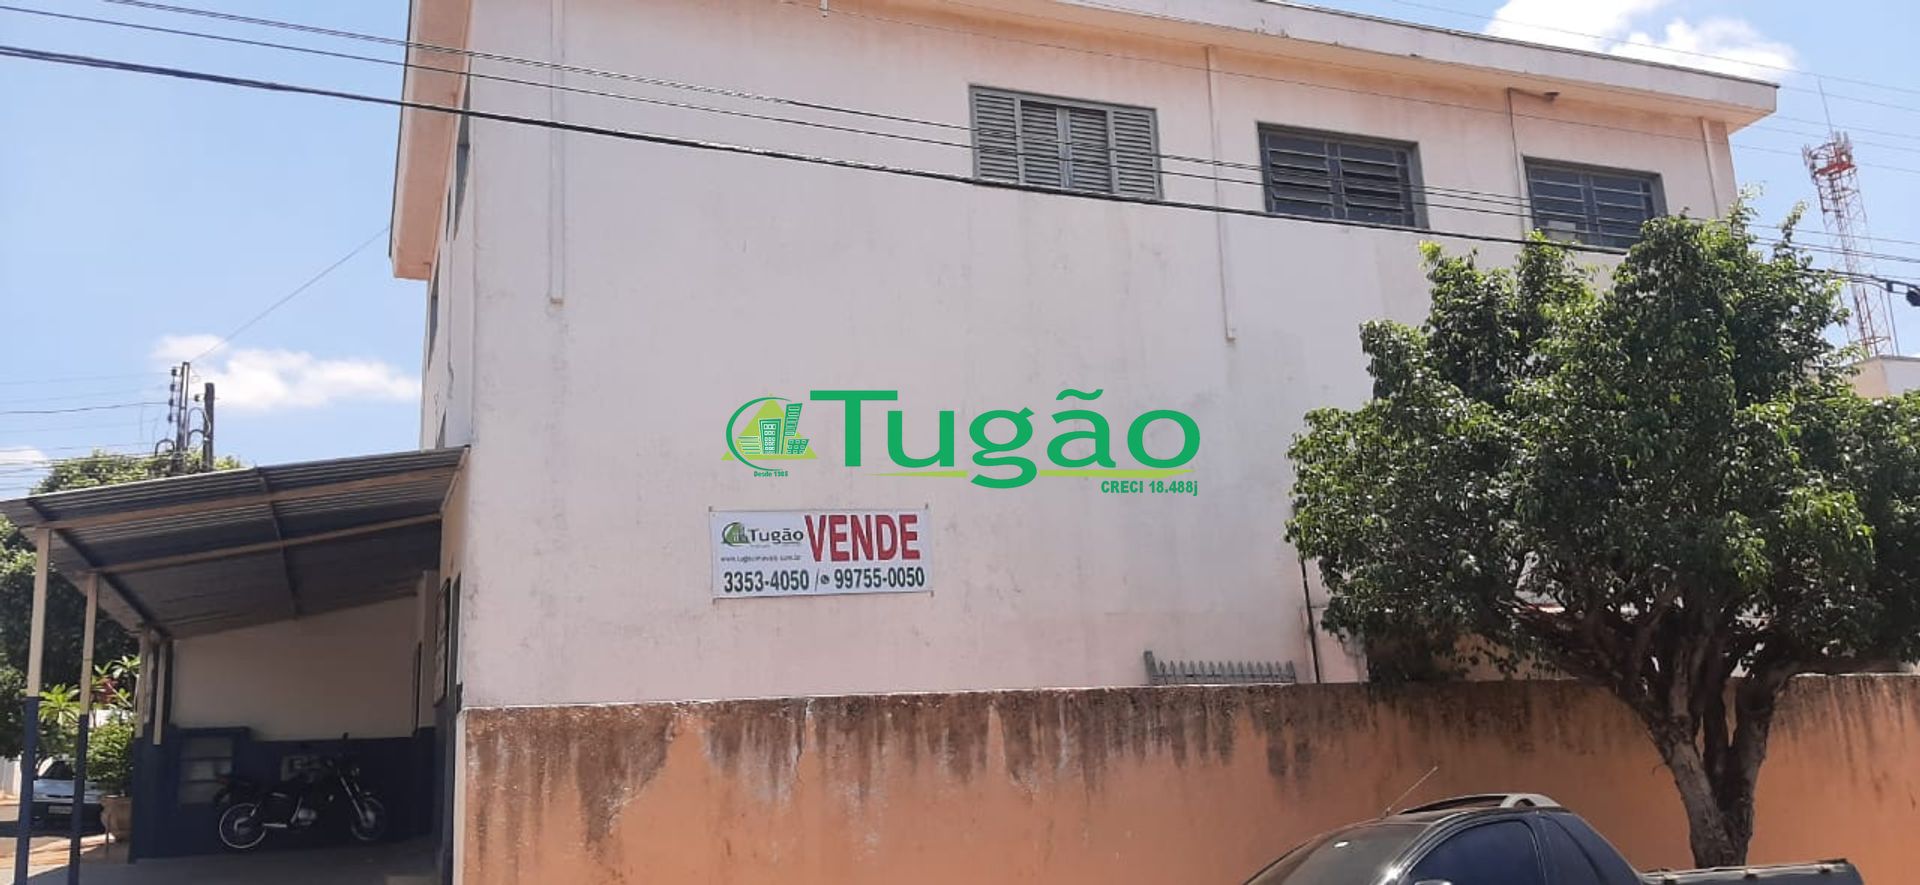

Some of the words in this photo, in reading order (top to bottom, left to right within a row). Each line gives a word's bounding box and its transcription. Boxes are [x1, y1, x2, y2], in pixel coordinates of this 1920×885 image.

[747, 528, 804, 544] Tugão
[804, 514, 921, 562] VENDE
[723, 569, 810, 593] 3353-4050
[834, 566, 925, 589] 99755-0050
